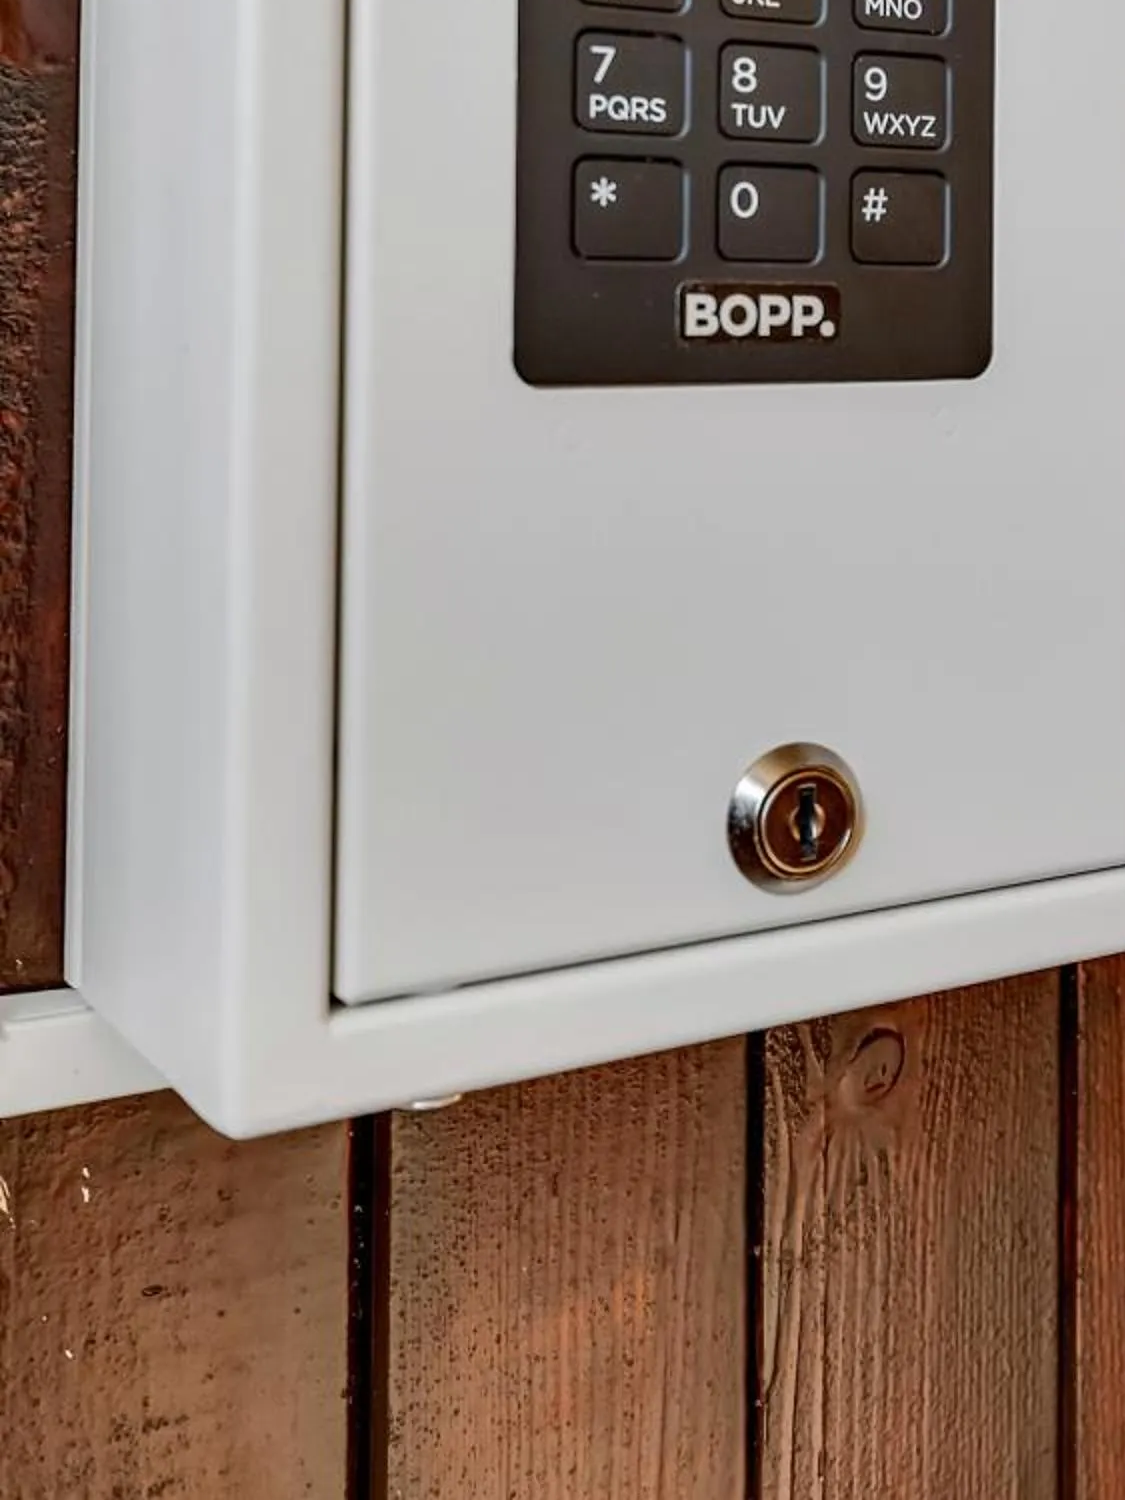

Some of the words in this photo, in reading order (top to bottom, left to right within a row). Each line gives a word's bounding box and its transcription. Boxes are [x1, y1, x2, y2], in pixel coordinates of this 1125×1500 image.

[590, 45, 616, 83] 7
[731, 56, 758, 93] 8
[864, 67, 888, 102] 9
[589, 93, 667, 123] PQRS
[731, 102, 786, 129] TUV
[863, 111, 936, 138] WXYZ
[730, 181, 759, 219] 0
[684, 292, 836, 338] BOPP.
